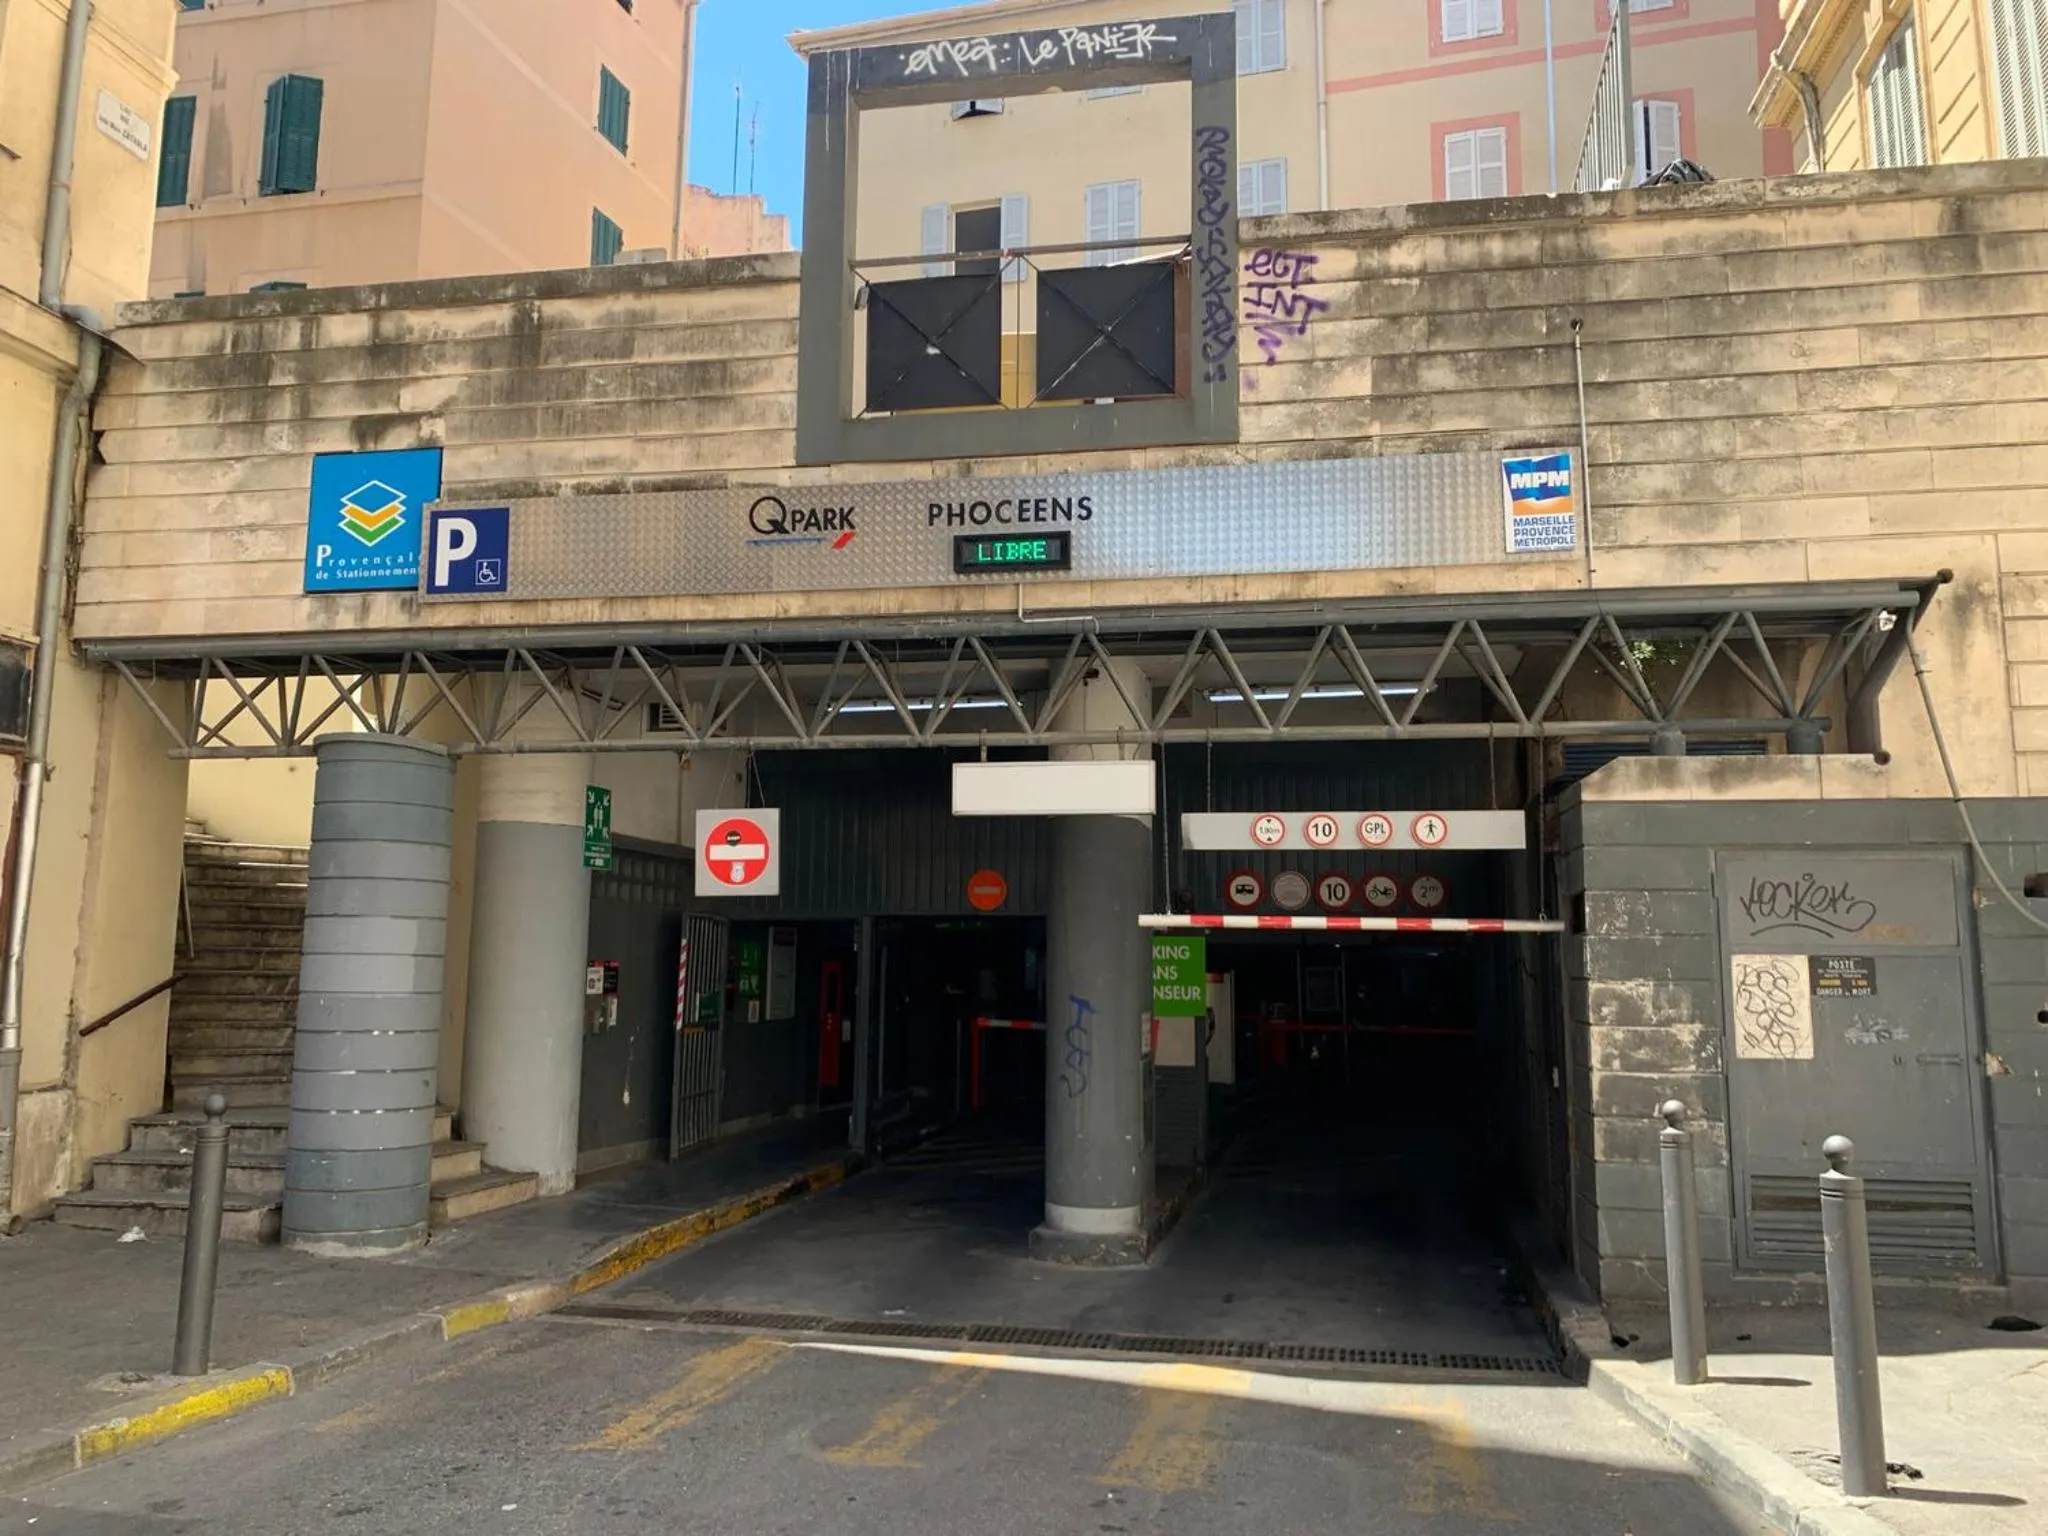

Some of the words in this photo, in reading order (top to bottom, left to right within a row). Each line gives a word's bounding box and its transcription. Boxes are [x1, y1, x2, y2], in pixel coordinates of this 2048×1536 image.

[1511, 470, 1570, 490] MPM
[927, 497, 1093, 527] PHOCEENS
[1513, 515, 1575, 527] MARSEILLE
[1513, 525, 1575, 538] PROVENCE
[1514, 535, 1577, 548] METROPOLE
[316, 543, 422, 568] Provençal
[434, 517, 478, 587] P
[977, 540, 1047, 561] LIBRE
[315, 570, 329, 580] de
[336, 566, 420, 579] Stationnemen
[1311, 822, 1333, 838] 10
[1364, 821, 1387, 835] GPL
[1325, 882, 1346, 901] 10
